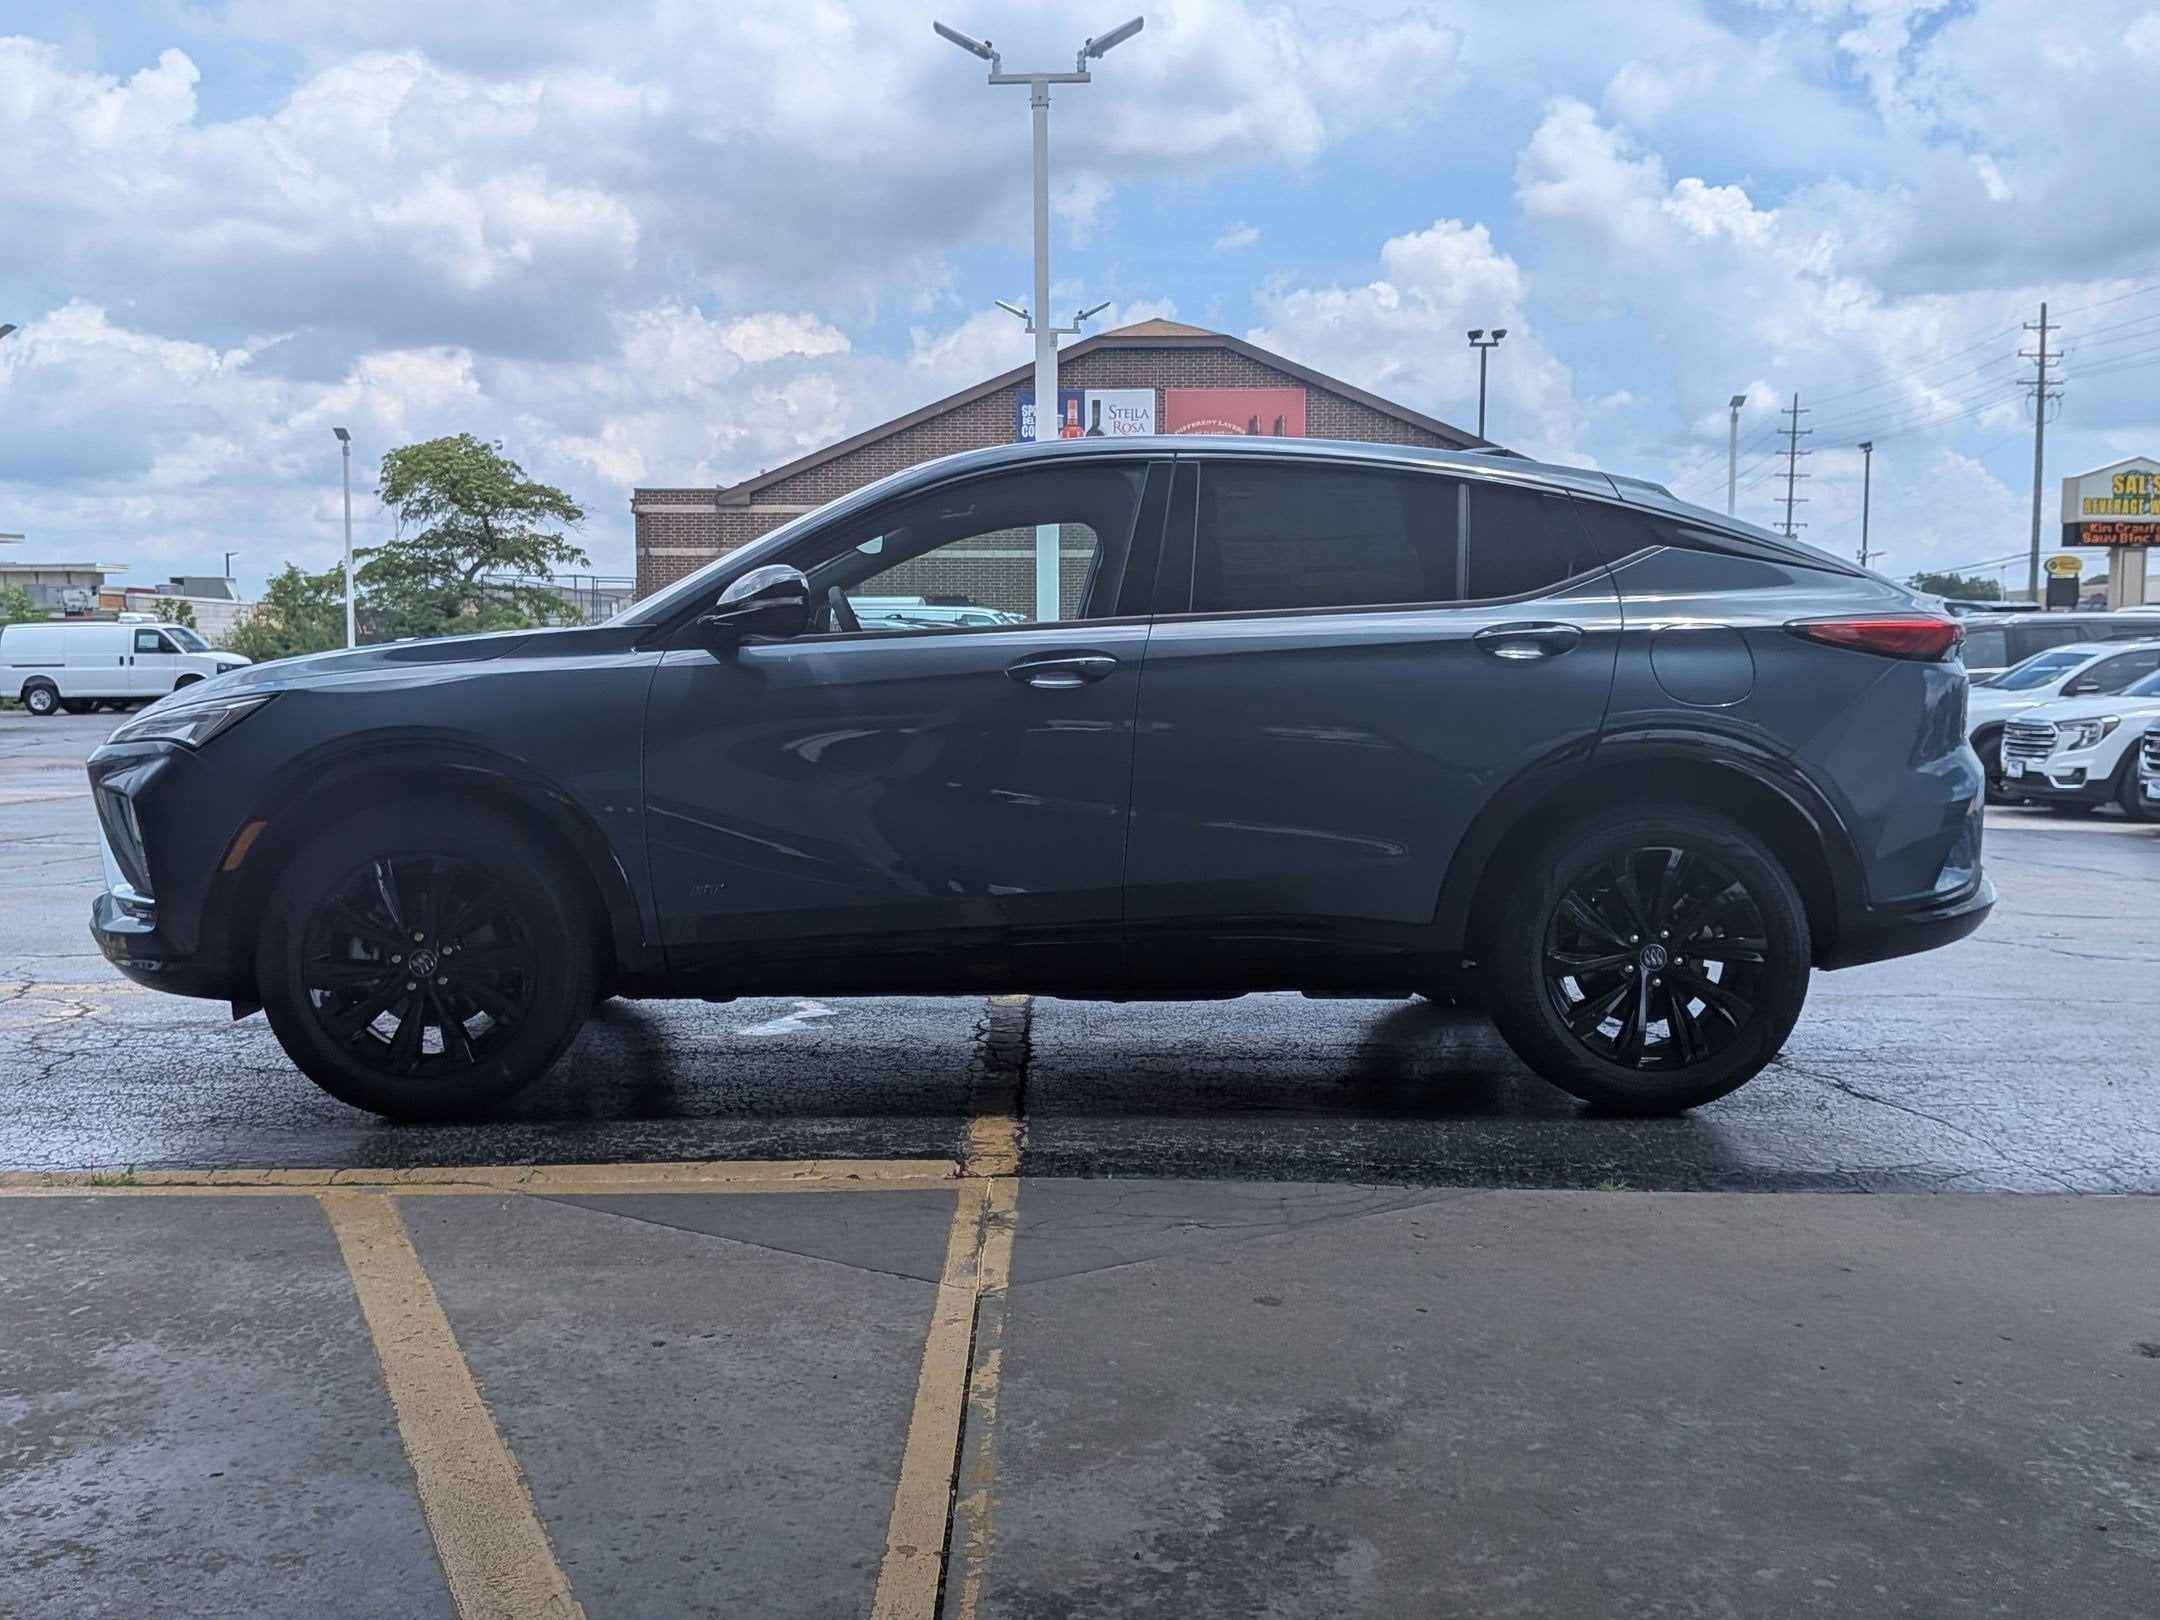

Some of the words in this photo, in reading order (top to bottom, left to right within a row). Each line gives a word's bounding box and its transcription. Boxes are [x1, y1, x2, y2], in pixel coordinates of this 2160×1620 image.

[1108, 404, 1149, 421] STELLA
[1113, 420, 1146, 436] ROSA
[1218, 420, 1246, 434] LAYERS
[2083, 498, 2144, 514] BEVERAGE
